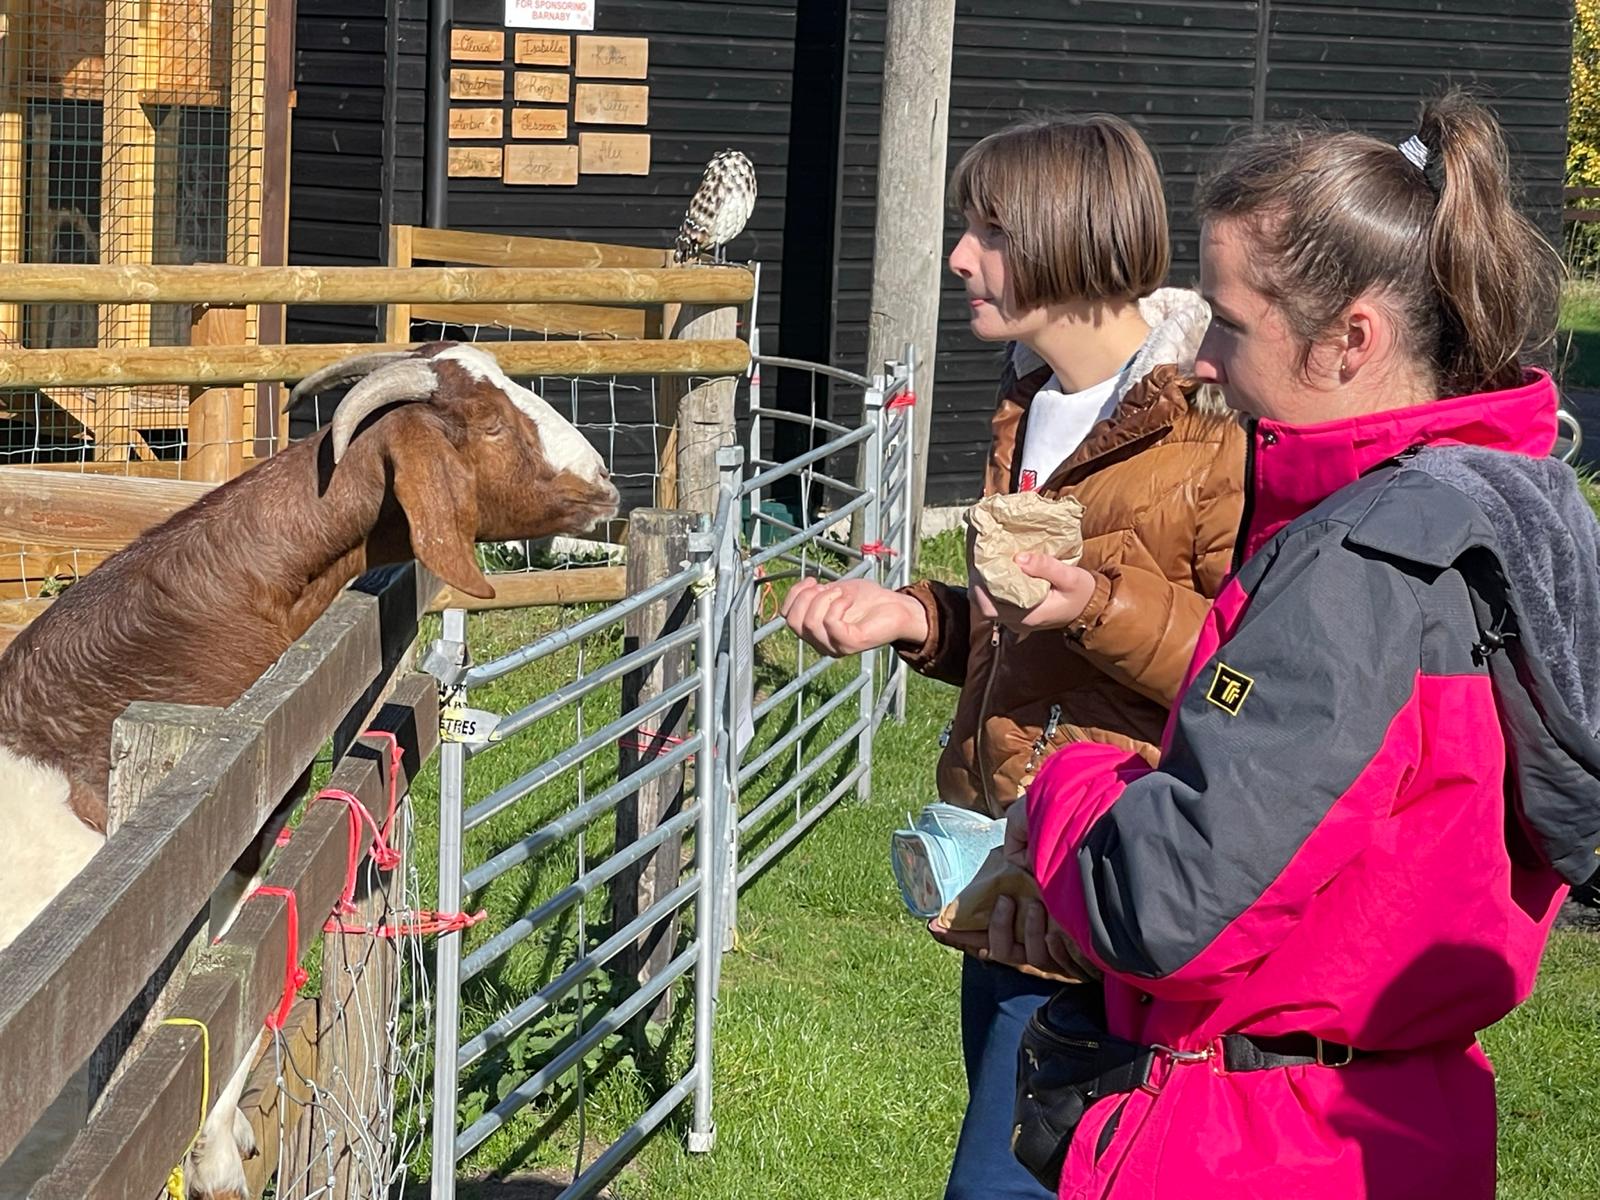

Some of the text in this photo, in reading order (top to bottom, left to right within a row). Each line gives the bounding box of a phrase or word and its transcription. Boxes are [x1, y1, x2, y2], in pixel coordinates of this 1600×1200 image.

[515, 0, 587, 11] FOR SPONSORING
[531, 11, 571, 21] BARNABY
[522, 39, 566, 55] Isabella
